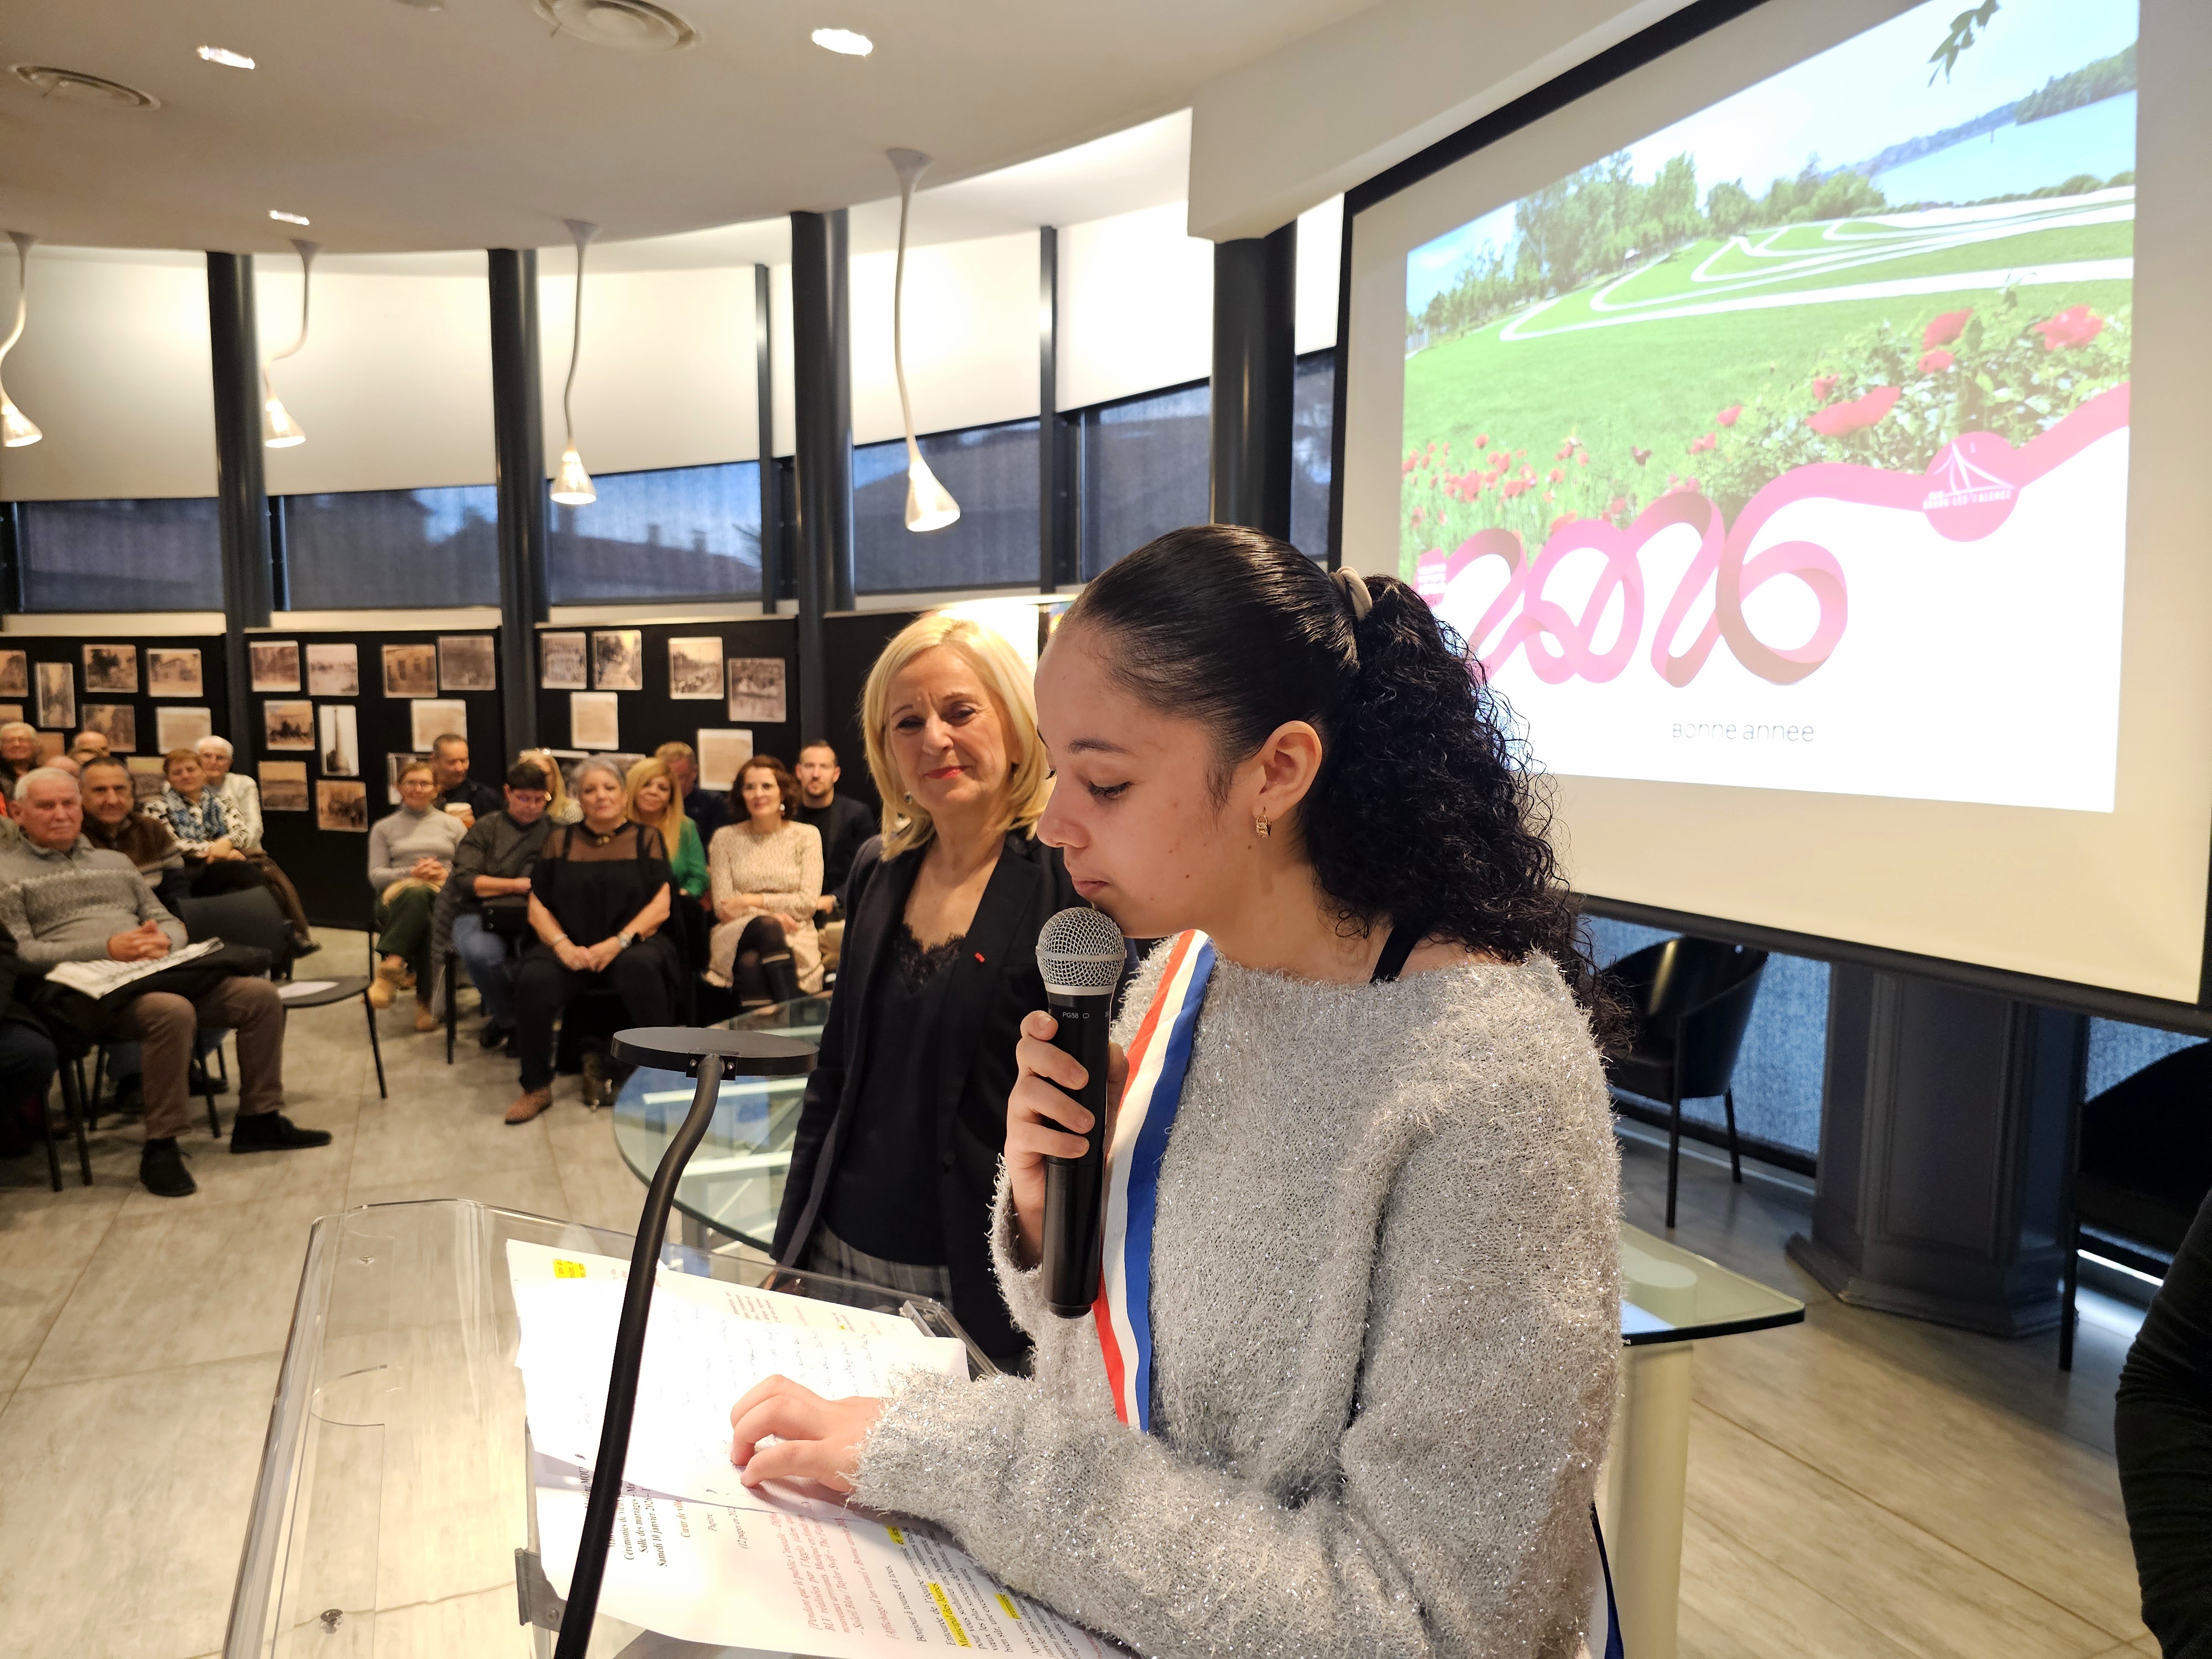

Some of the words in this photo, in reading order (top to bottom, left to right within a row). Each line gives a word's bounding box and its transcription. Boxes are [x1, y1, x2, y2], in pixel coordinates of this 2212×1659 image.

[632, 1499, 644, 1525] mariages
[635, 1526, 645, 1536] des
[648, 1512, 662, 1534] janvier
[680, 1521, 690, 1537] Cœur
[619, 1524, 634, 1560] Cérémonies
[637, 1538, 649, 1553] Salle
[820, 1537, 830, 1547] The
[653, 1543, 667, 1567] Samedi
[811, 1546, 826, 1571] Musique
[825, 1554, 838, 1569] Swift
[787, 1559, 804, 1580] public
[806, 1571, 819, 1583] par
[833, 1571, 847, 1589] Taylor
[940, 1574, 950, 1585] une
[843, 1595, 855, 1609] Bleu
[897, 1590, 911, 1610] toutes
[947, 1587, 966, 1615] souhaiter
[930, 1606, 940, 1615] de
[943, 1604, 952, 1614] des
[971, 1608, 984, 1621] plus
[963, 1617, 974, 1632] vous
[978, 1621, 988, 1632] les
[987, 1613, 997, 1625] une
[909, 1616, 927, 1642] Bonjour
[935, 1617, 957, 1646] Entourée
[946, 1615, 971, 1648] Municipal
[972, 1634, 988, 1650] pour
[1001, 1639, 1014, 1652] bien
[1025, 1637, 1041, 1656] Après
